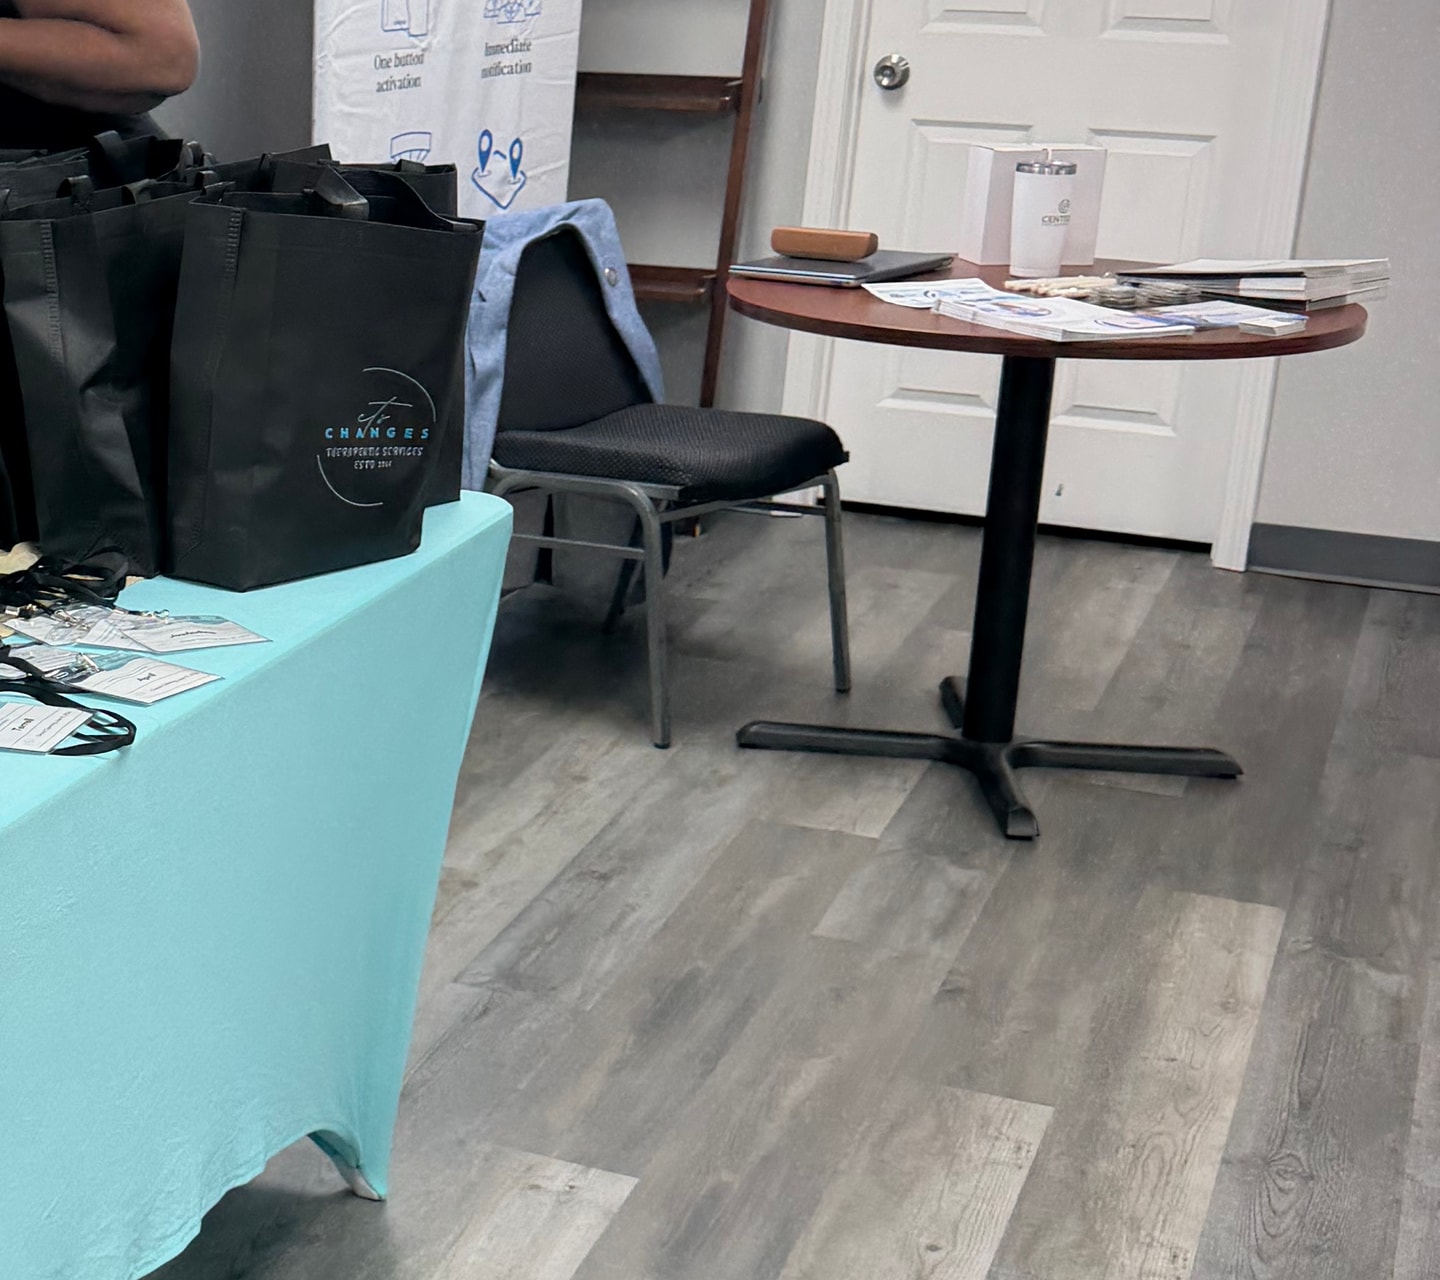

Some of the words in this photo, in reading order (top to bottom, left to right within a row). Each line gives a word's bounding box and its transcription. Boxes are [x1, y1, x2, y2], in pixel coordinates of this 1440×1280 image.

[484, 39, 532, 57] Immediate
[374, 54, 393, 70] One
[394, 51, 424, 67] button
[481, 60, 532, 79] notification
[376, 74, 421, 93] activation
[324, 427, 430, 439] CHANGES
[382, 446, 424, 457] SERVICES
